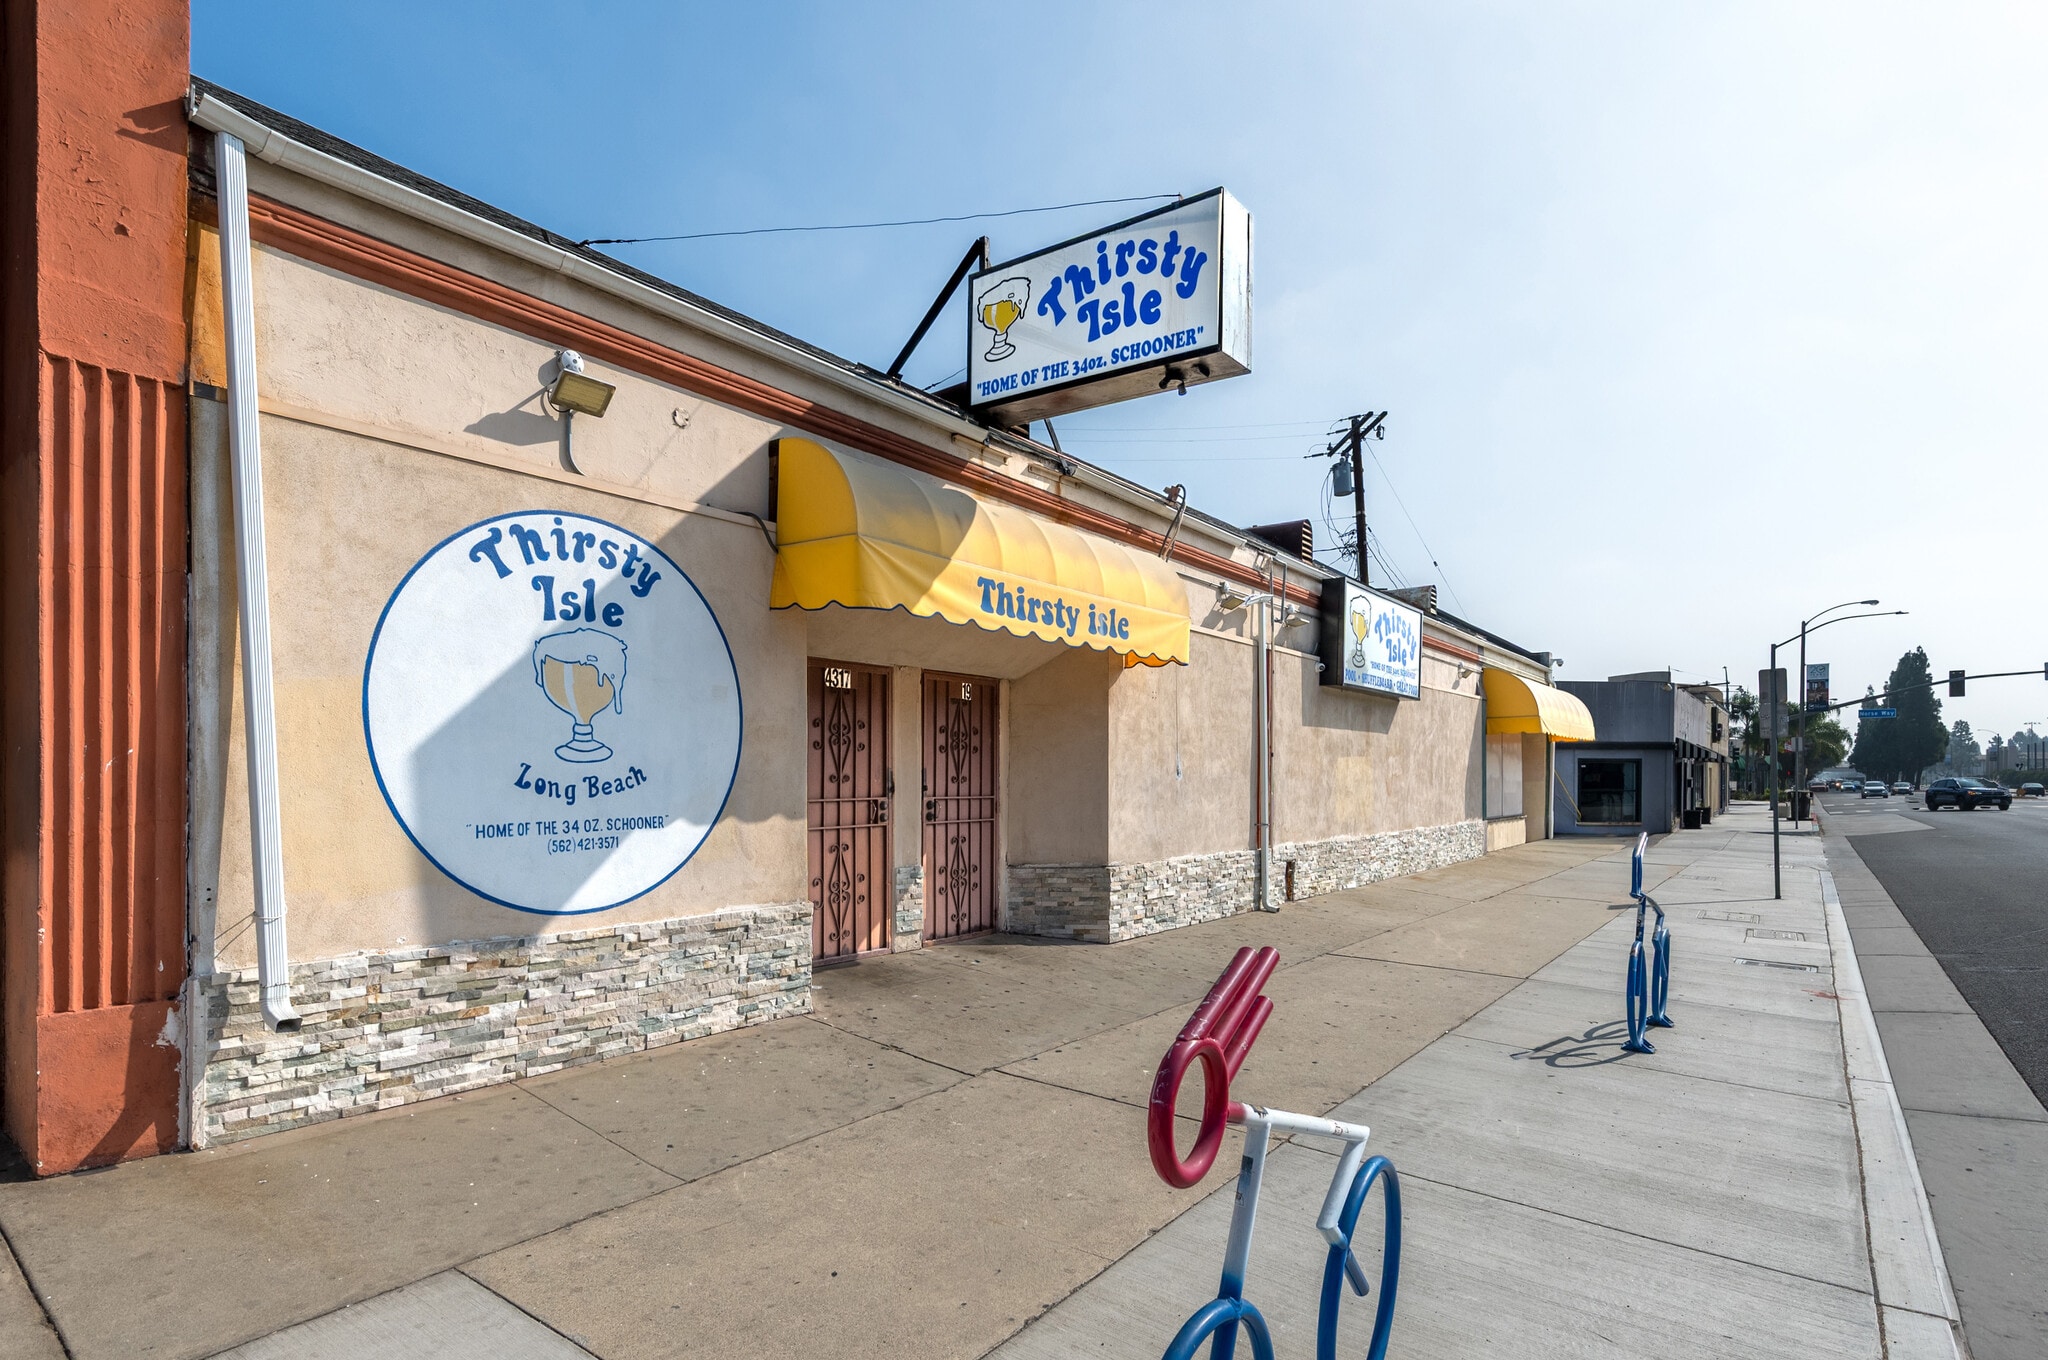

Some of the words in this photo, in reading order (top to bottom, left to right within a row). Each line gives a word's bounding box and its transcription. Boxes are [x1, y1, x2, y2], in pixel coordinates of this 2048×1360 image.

[1037, 230, 1208, 327] Thirsty
[1077, 281, 1162, 343] Isle
[977, 373, 1018, 397] "HOME
[1021, 369, 1038, 387] OF
[1041, 361, 1070, 382] THE
[1111, 326, 1204, 364] SCHOONER"
[469, 517, 662, 598] Thirsty
[531, 575, 625, 628] Isle
[977, 576, 1080, 638] Thirsty
[1087, 604, 1130, 641] isle
[1375, 608, 1416, 660] Thirsty
[1386, 639, 1407, 666] Isle
[825, 668, 851, 688] 4317
[962, 683, 972, 700] 19
[513, 762, 576, 805] Long
[583, 765, 647, 799] Beach
[517, 822, 531, 836] OF
[535, 821, 559, 835] THE
[562, 819, 580, 834] 34
[583, 818, 603, 833] OZ.
[606, 815, 670, 831] SCHOONER"
